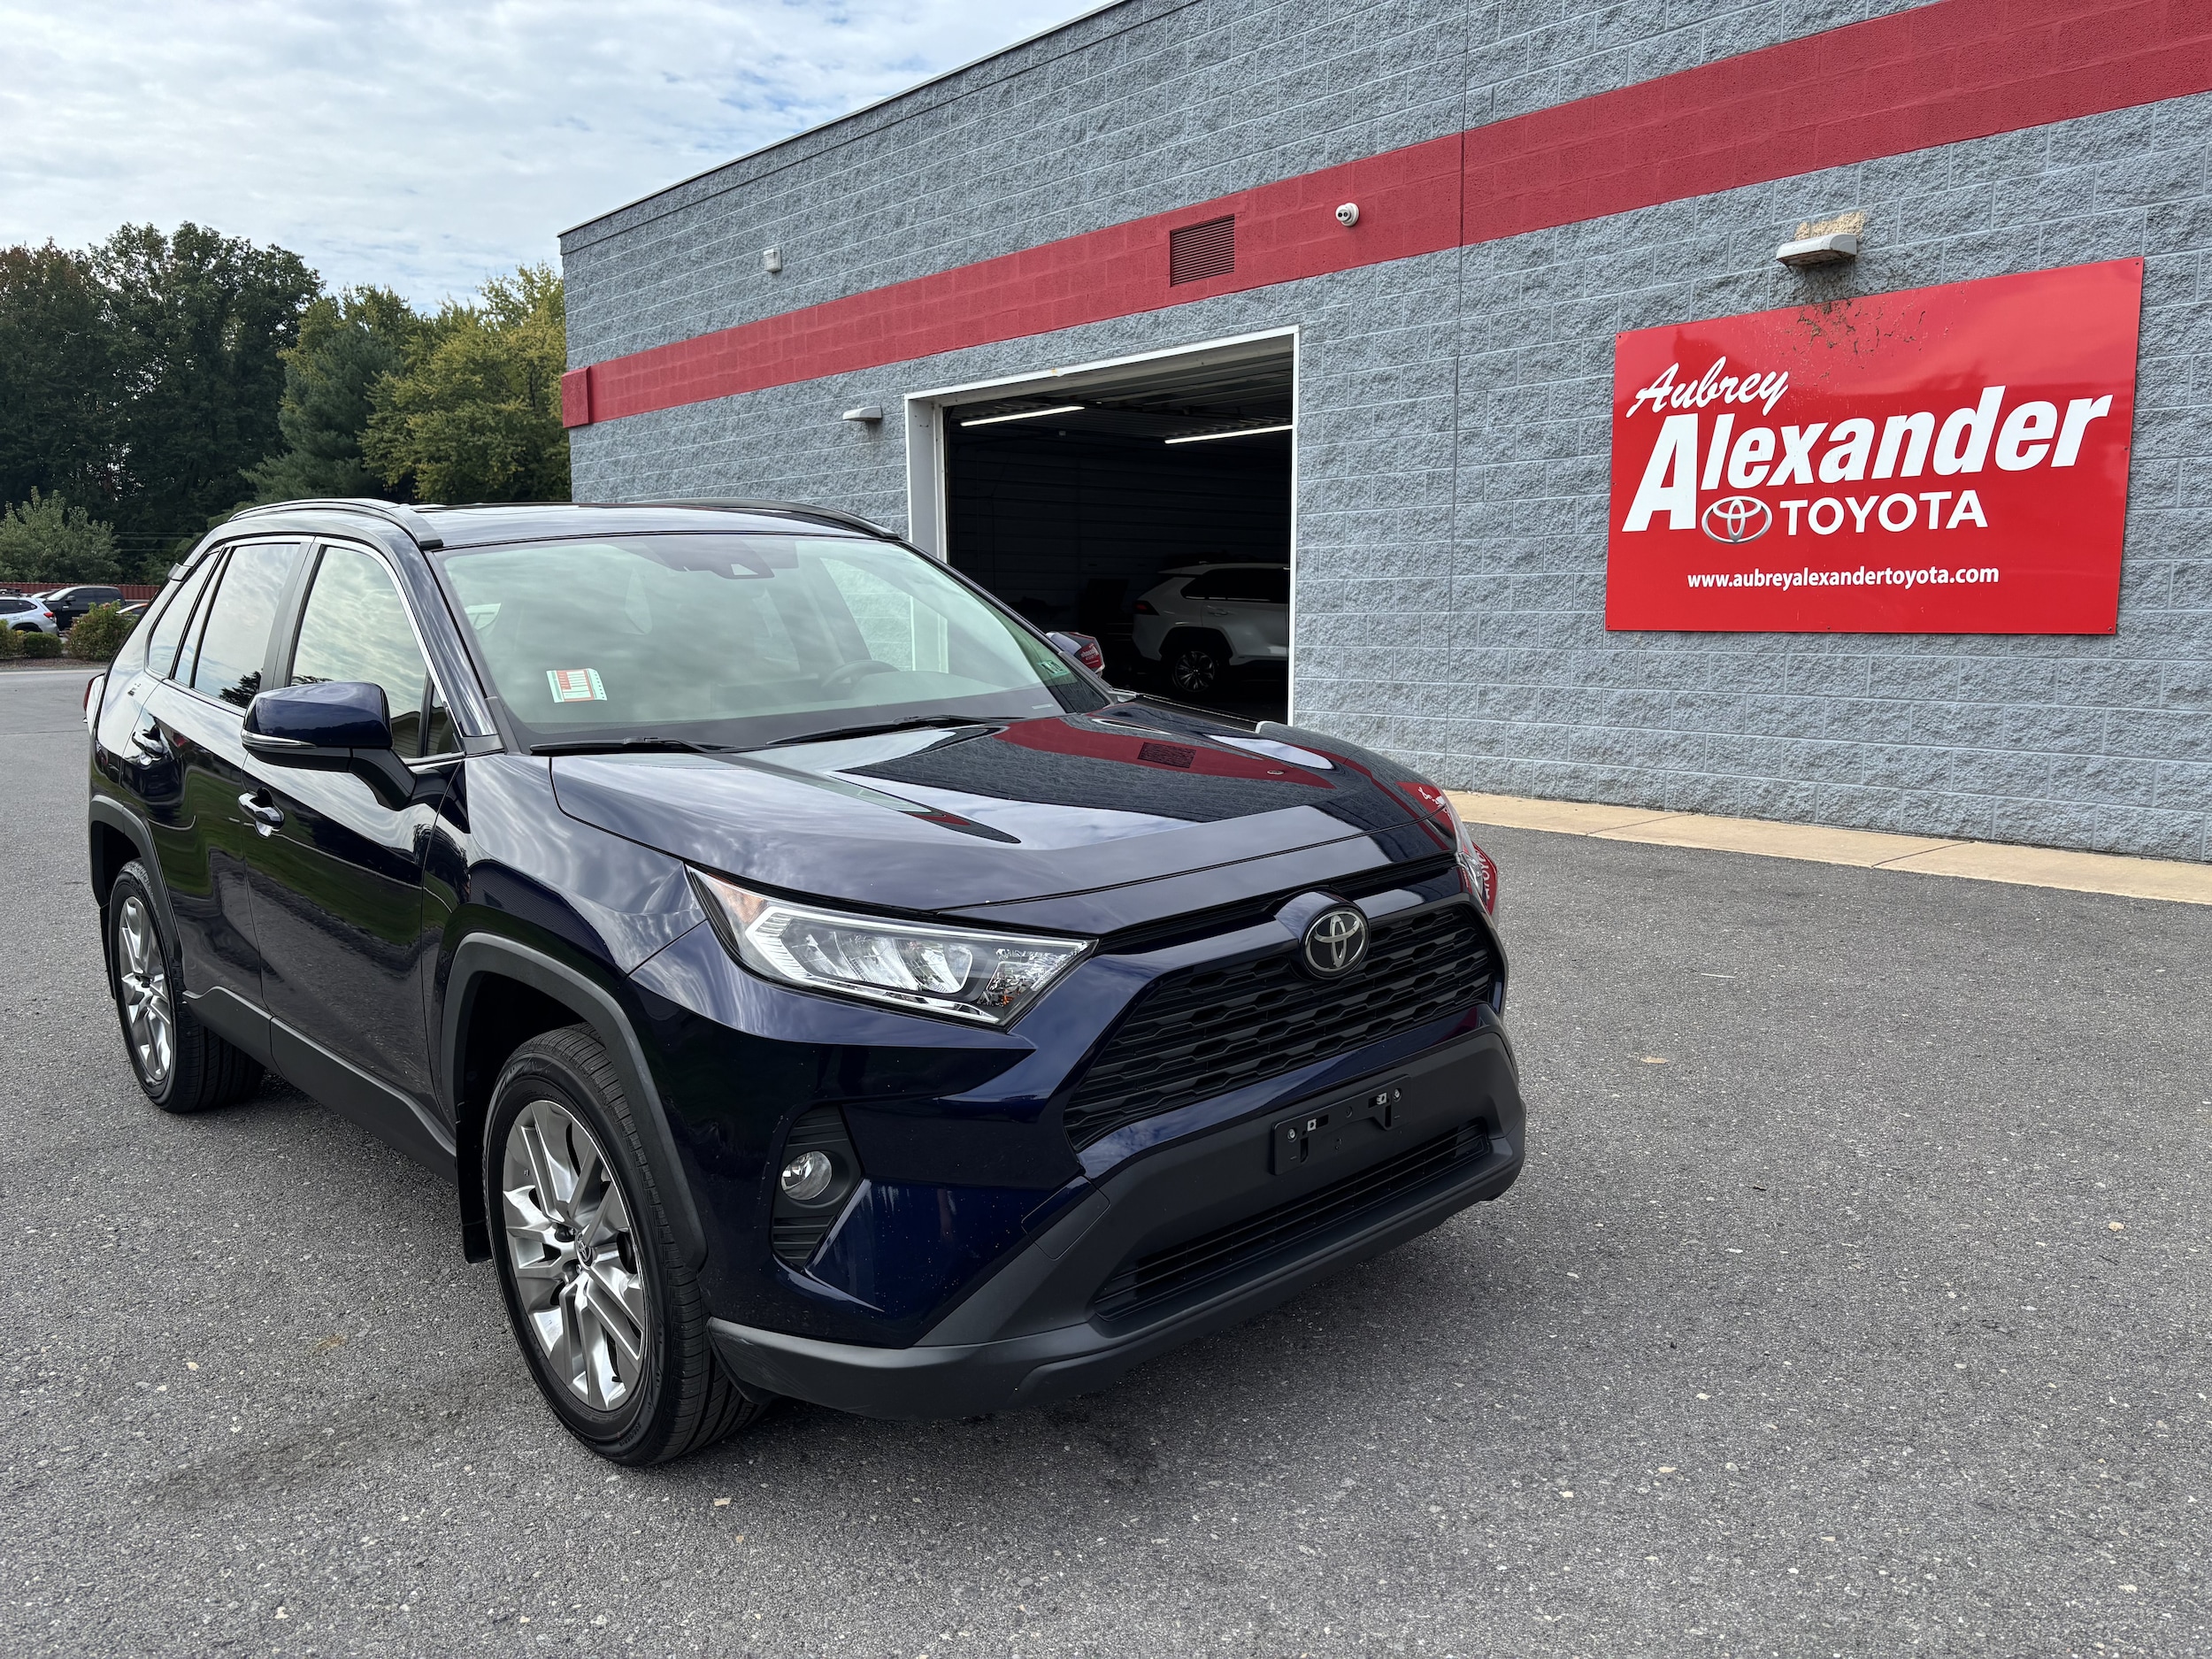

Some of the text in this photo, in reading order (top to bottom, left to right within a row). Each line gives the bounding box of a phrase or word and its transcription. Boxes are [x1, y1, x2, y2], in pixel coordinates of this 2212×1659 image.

[1626, 356, 1789, 419] Aubrey
[1622, 385, 2114, 533] Alexander
[1779, 489, 1988, 536] TOYOTA
[1687, 565, 2000, 591] www.aubreyalexandertoyota.com
